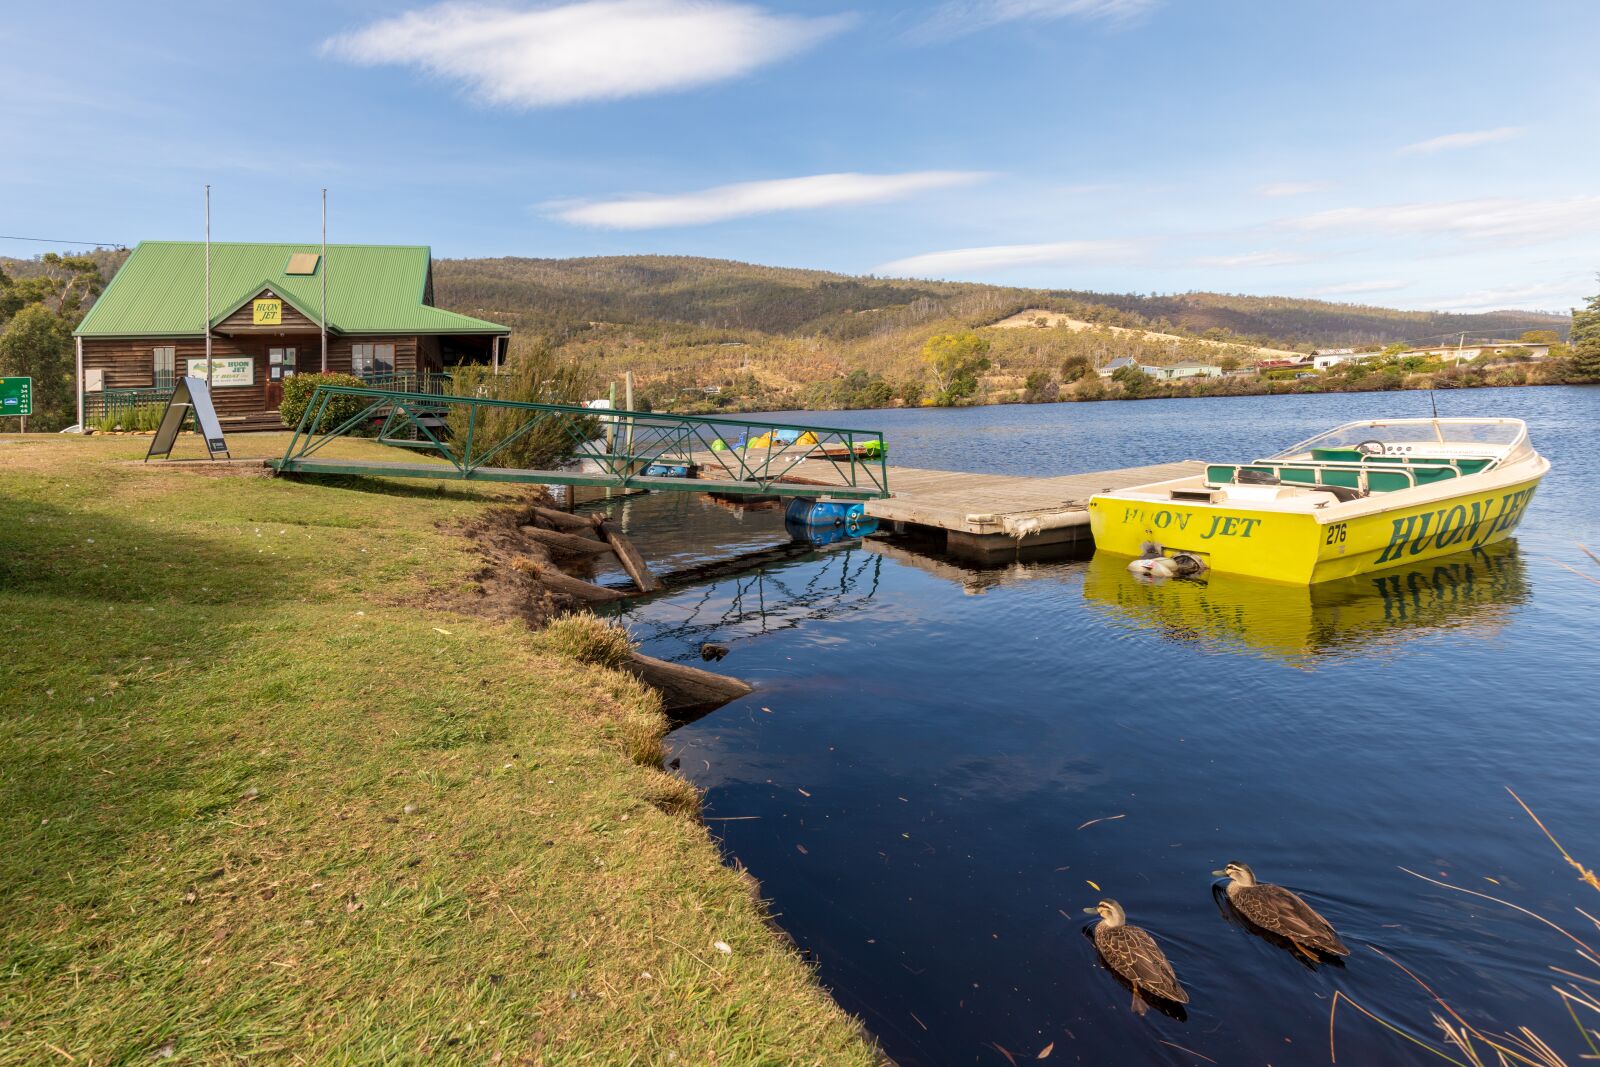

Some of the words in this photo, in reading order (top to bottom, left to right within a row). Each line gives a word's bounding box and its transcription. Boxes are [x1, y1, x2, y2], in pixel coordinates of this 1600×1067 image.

[259, 312, 277, 321] JET
[1200, 515, 1262, 539] JET
[1326, 522, 1347, 545] 276
[1374, 499, 1495, 565] HUON
[1472, 484, 1535, 549] JET
